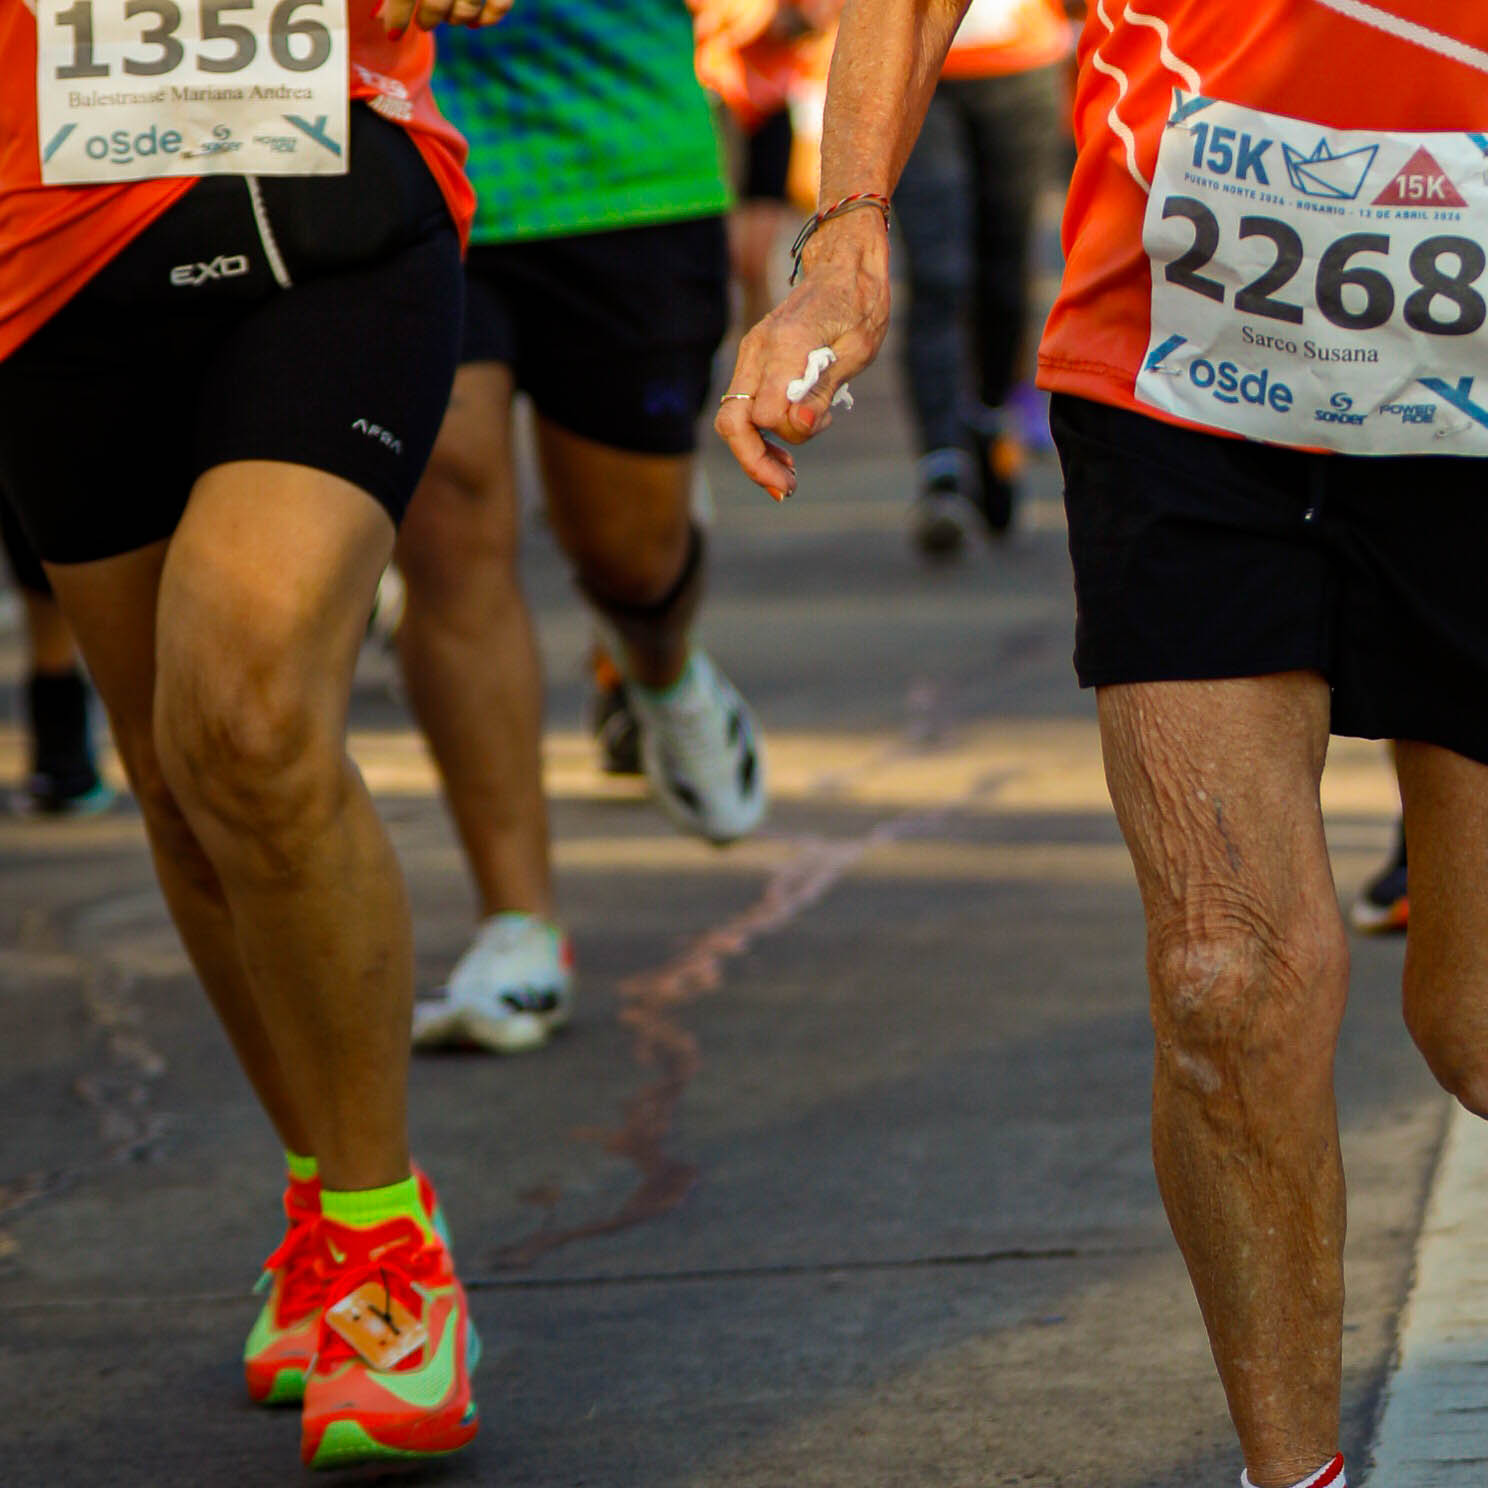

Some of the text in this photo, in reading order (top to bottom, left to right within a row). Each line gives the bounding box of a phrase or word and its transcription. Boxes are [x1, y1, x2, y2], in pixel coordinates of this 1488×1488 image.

[171, 85, 244, 103] Mariana
[249, 83, 313, 101] Andrea
[86, 123, 183, 163] osde
[1190, 121, 1274, 186] 15K
[1396, 174, 1447, 200] 15K
[169, 255, 249, 287] EXO
[1161, 195, 1487, 337] 2268
[1241, 325, 1379, 363] Sarco Susana
[1189, 358, 1293, 413] osde
